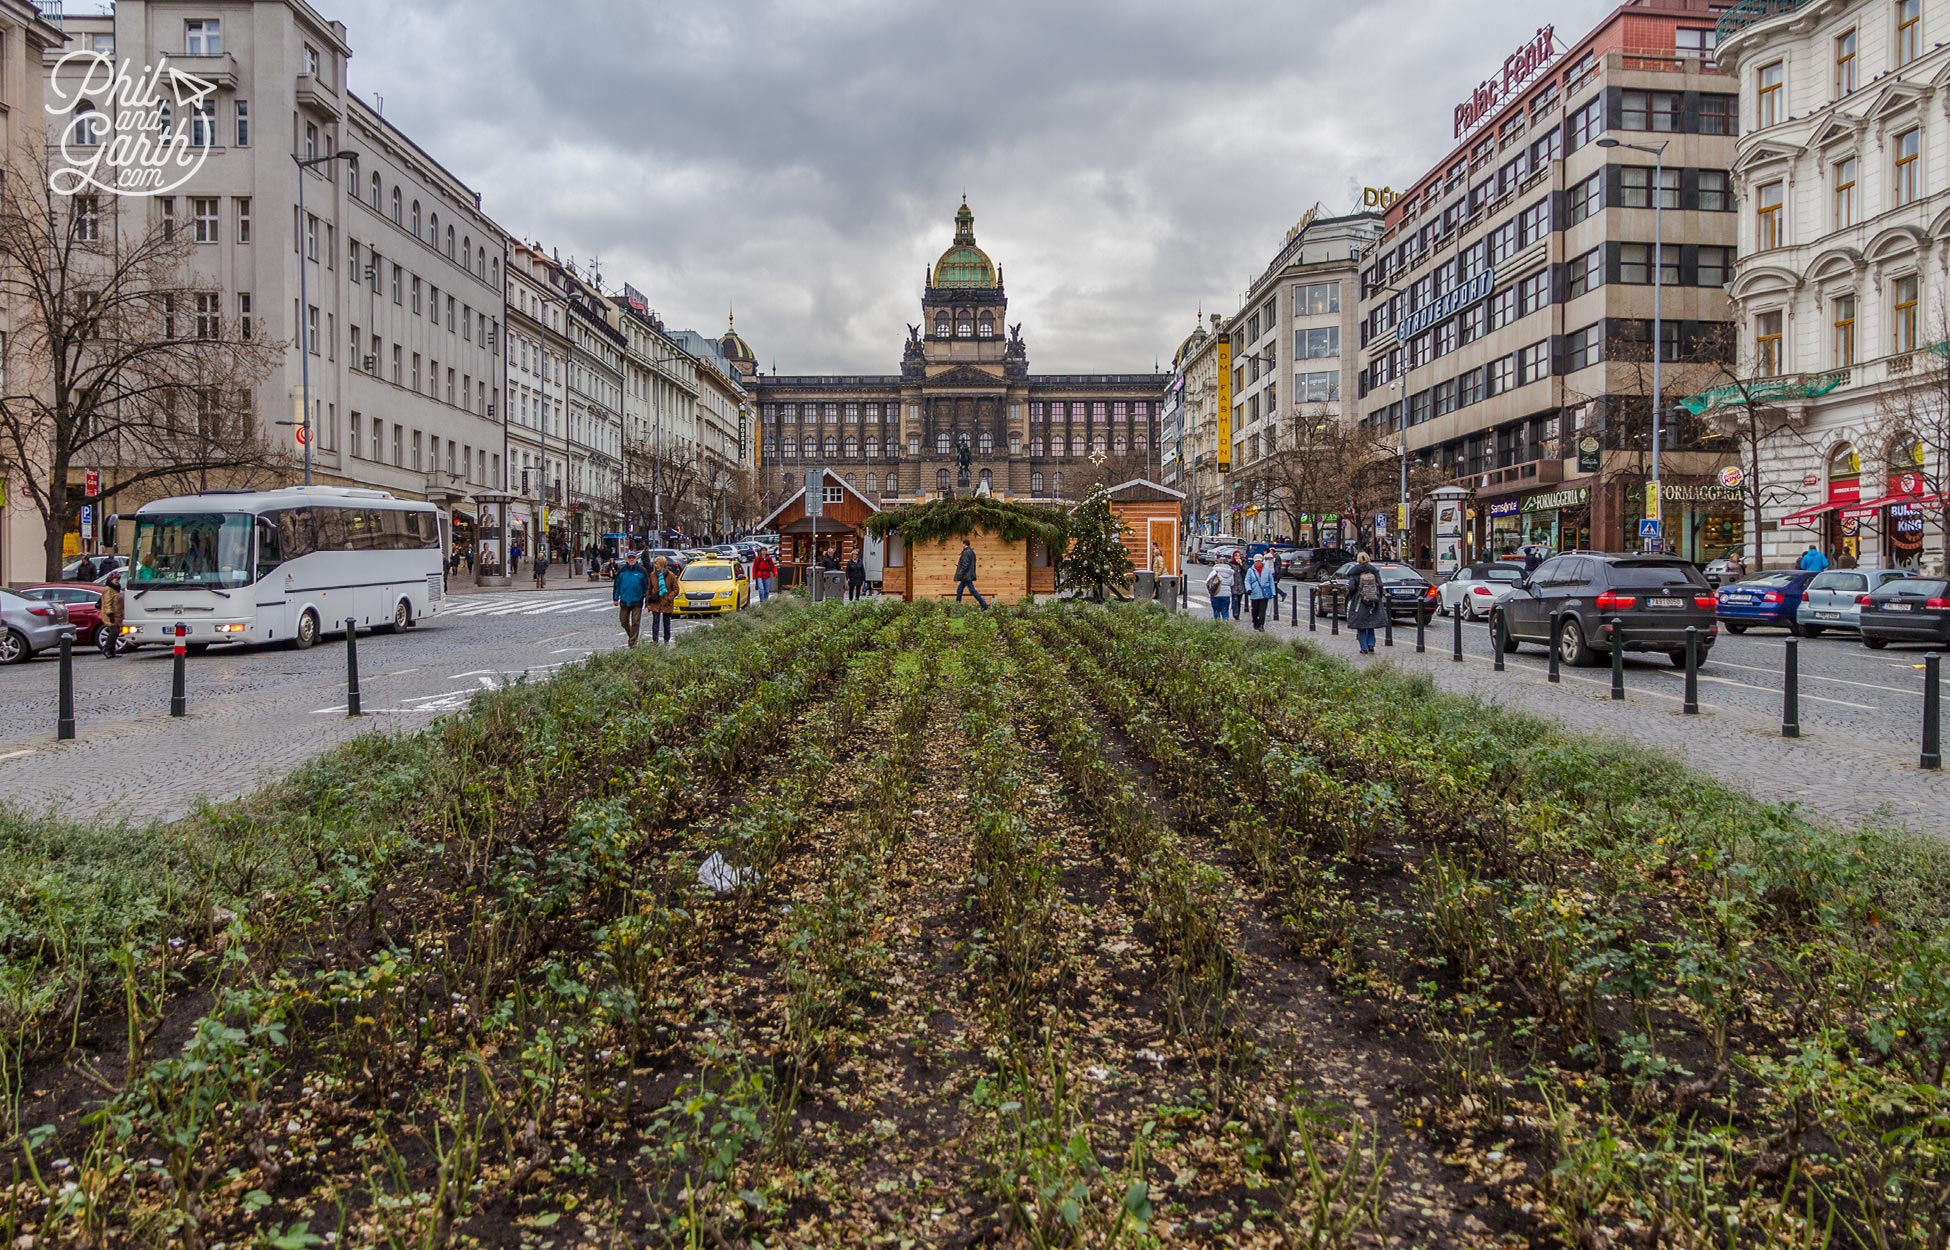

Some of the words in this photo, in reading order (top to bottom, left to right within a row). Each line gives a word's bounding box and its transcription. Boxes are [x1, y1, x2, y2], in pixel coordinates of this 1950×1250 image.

[1454, 79, 1498, 139] Palác
[1503, 26, 1555, 97] Fénix
[1399, 272, 1488, 340] STROJEXPORT
[1220, 384, 1228, 456] FASHION
[1724, 473, 1742, 484] KING
[1490, 500, 1517, 514] Samsonite
[1536, 489, 1578, 509] FORMAGGERIA
[84, 507, 90, 518] P
[1897, 519, 1923, 532] KING
